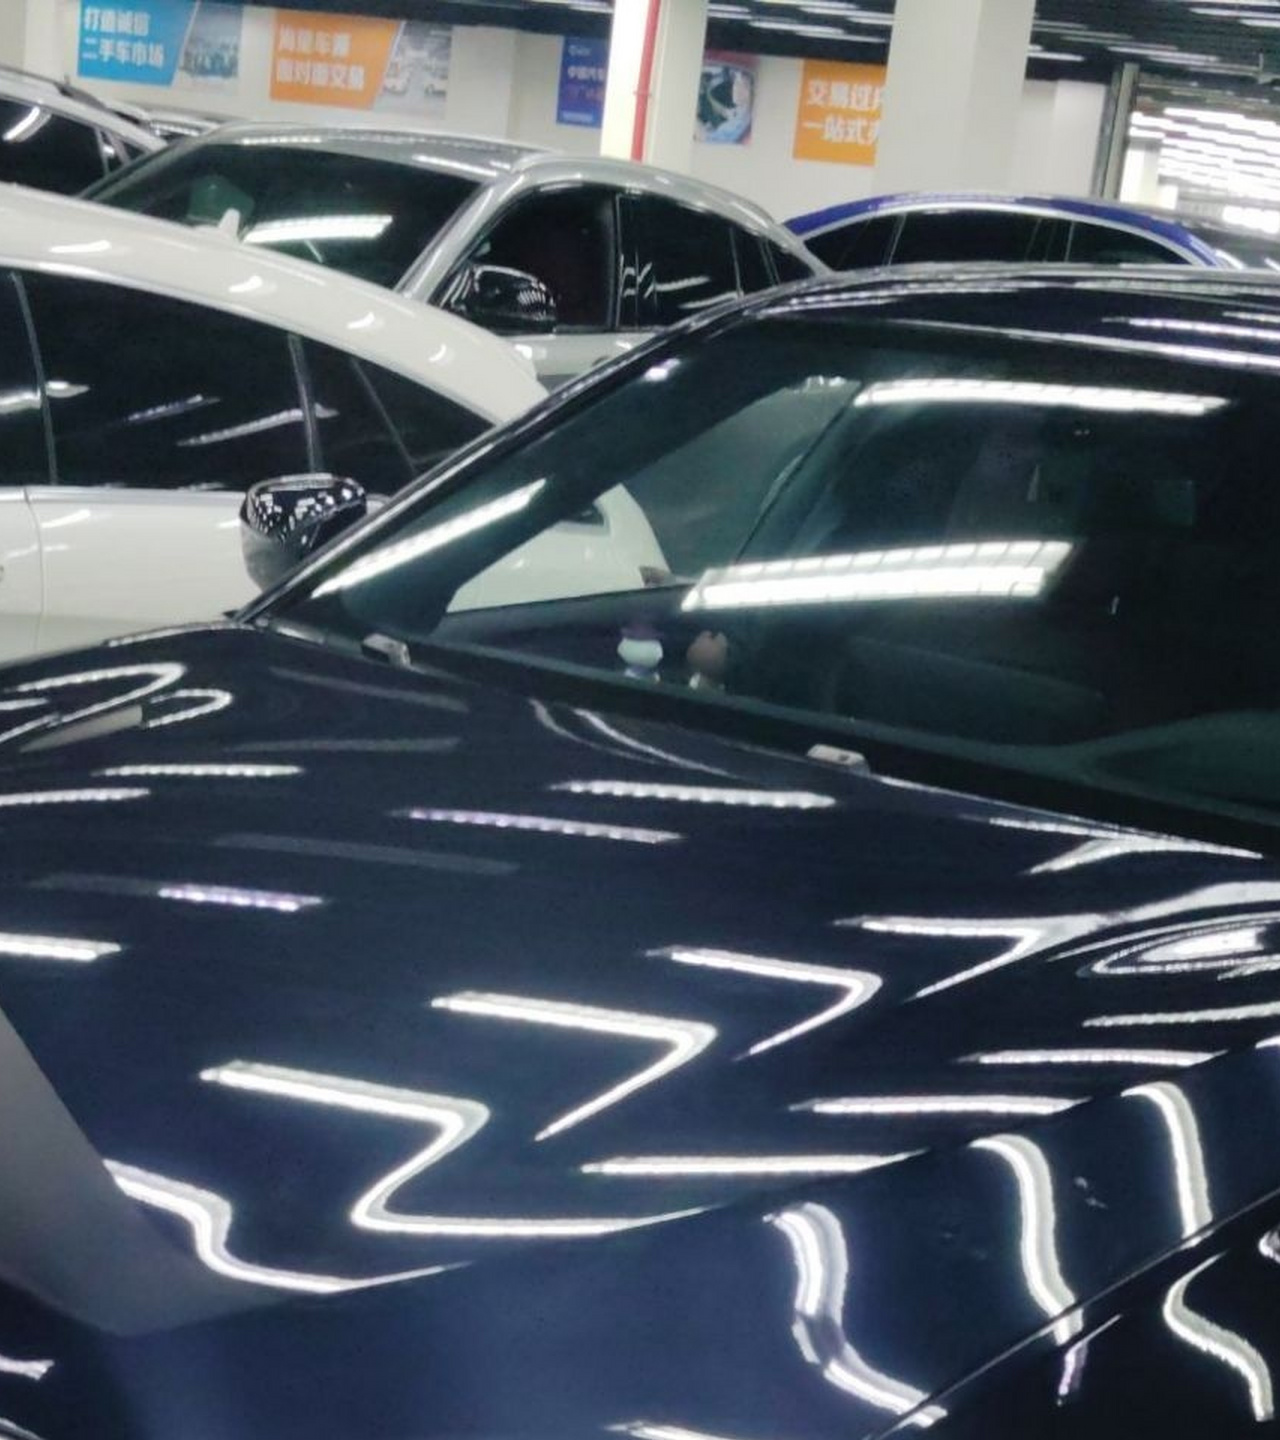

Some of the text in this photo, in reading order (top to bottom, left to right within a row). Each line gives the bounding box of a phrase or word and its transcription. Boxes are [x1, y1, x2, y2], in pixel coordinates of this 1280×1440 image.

[82, 37, 165, 69] 二手车市场
